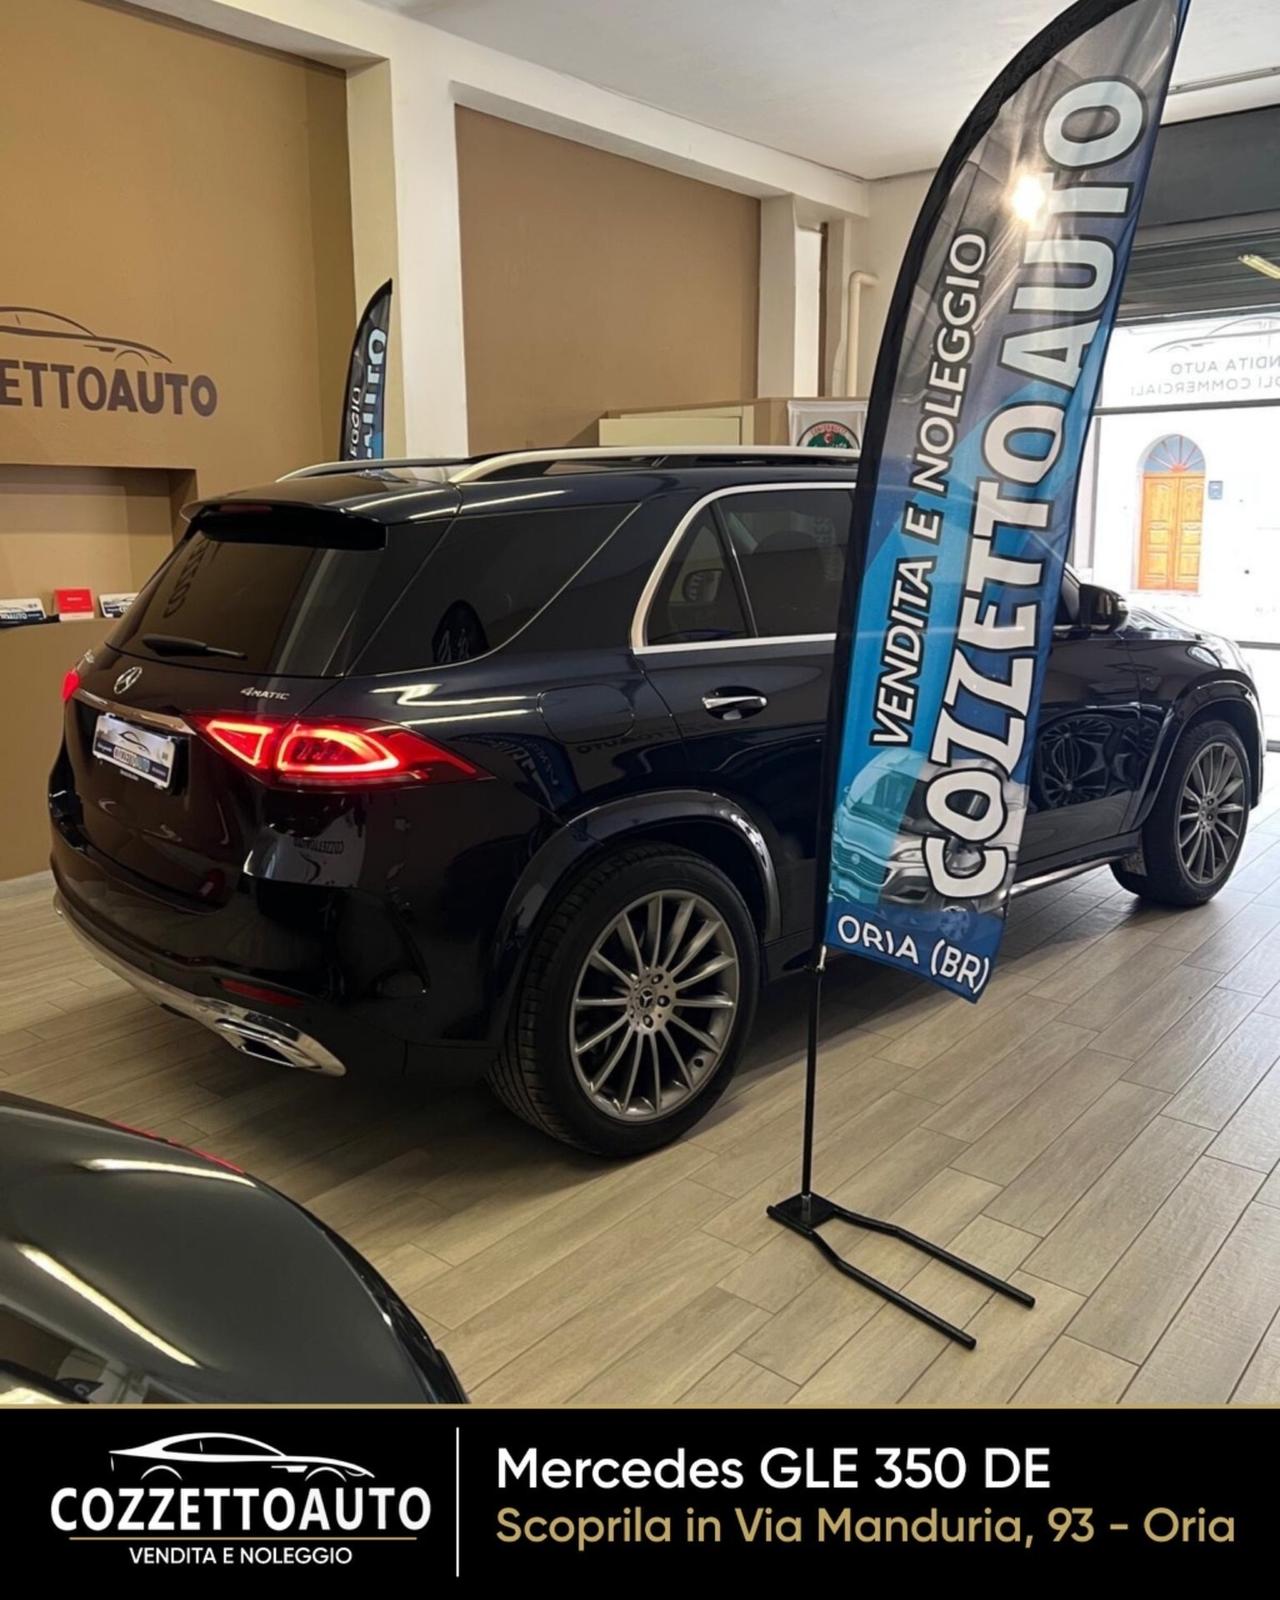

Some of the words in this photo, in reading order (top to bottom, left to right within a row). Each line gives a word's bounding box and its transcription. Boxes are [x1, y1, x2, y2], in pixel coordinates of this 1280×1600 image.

[912, 233, 987, 493] NOLEGGIO
[905, 506, 940, 540] E
[924, 80, 1145, 897] COZZETTOAUTO
[240, 687, 290, 701] 4MATIC
[873, 561, 933, 745] VENDITA
[837, 915, 920, 965] ORIA
[931, 938, 990, 994] (BR)
